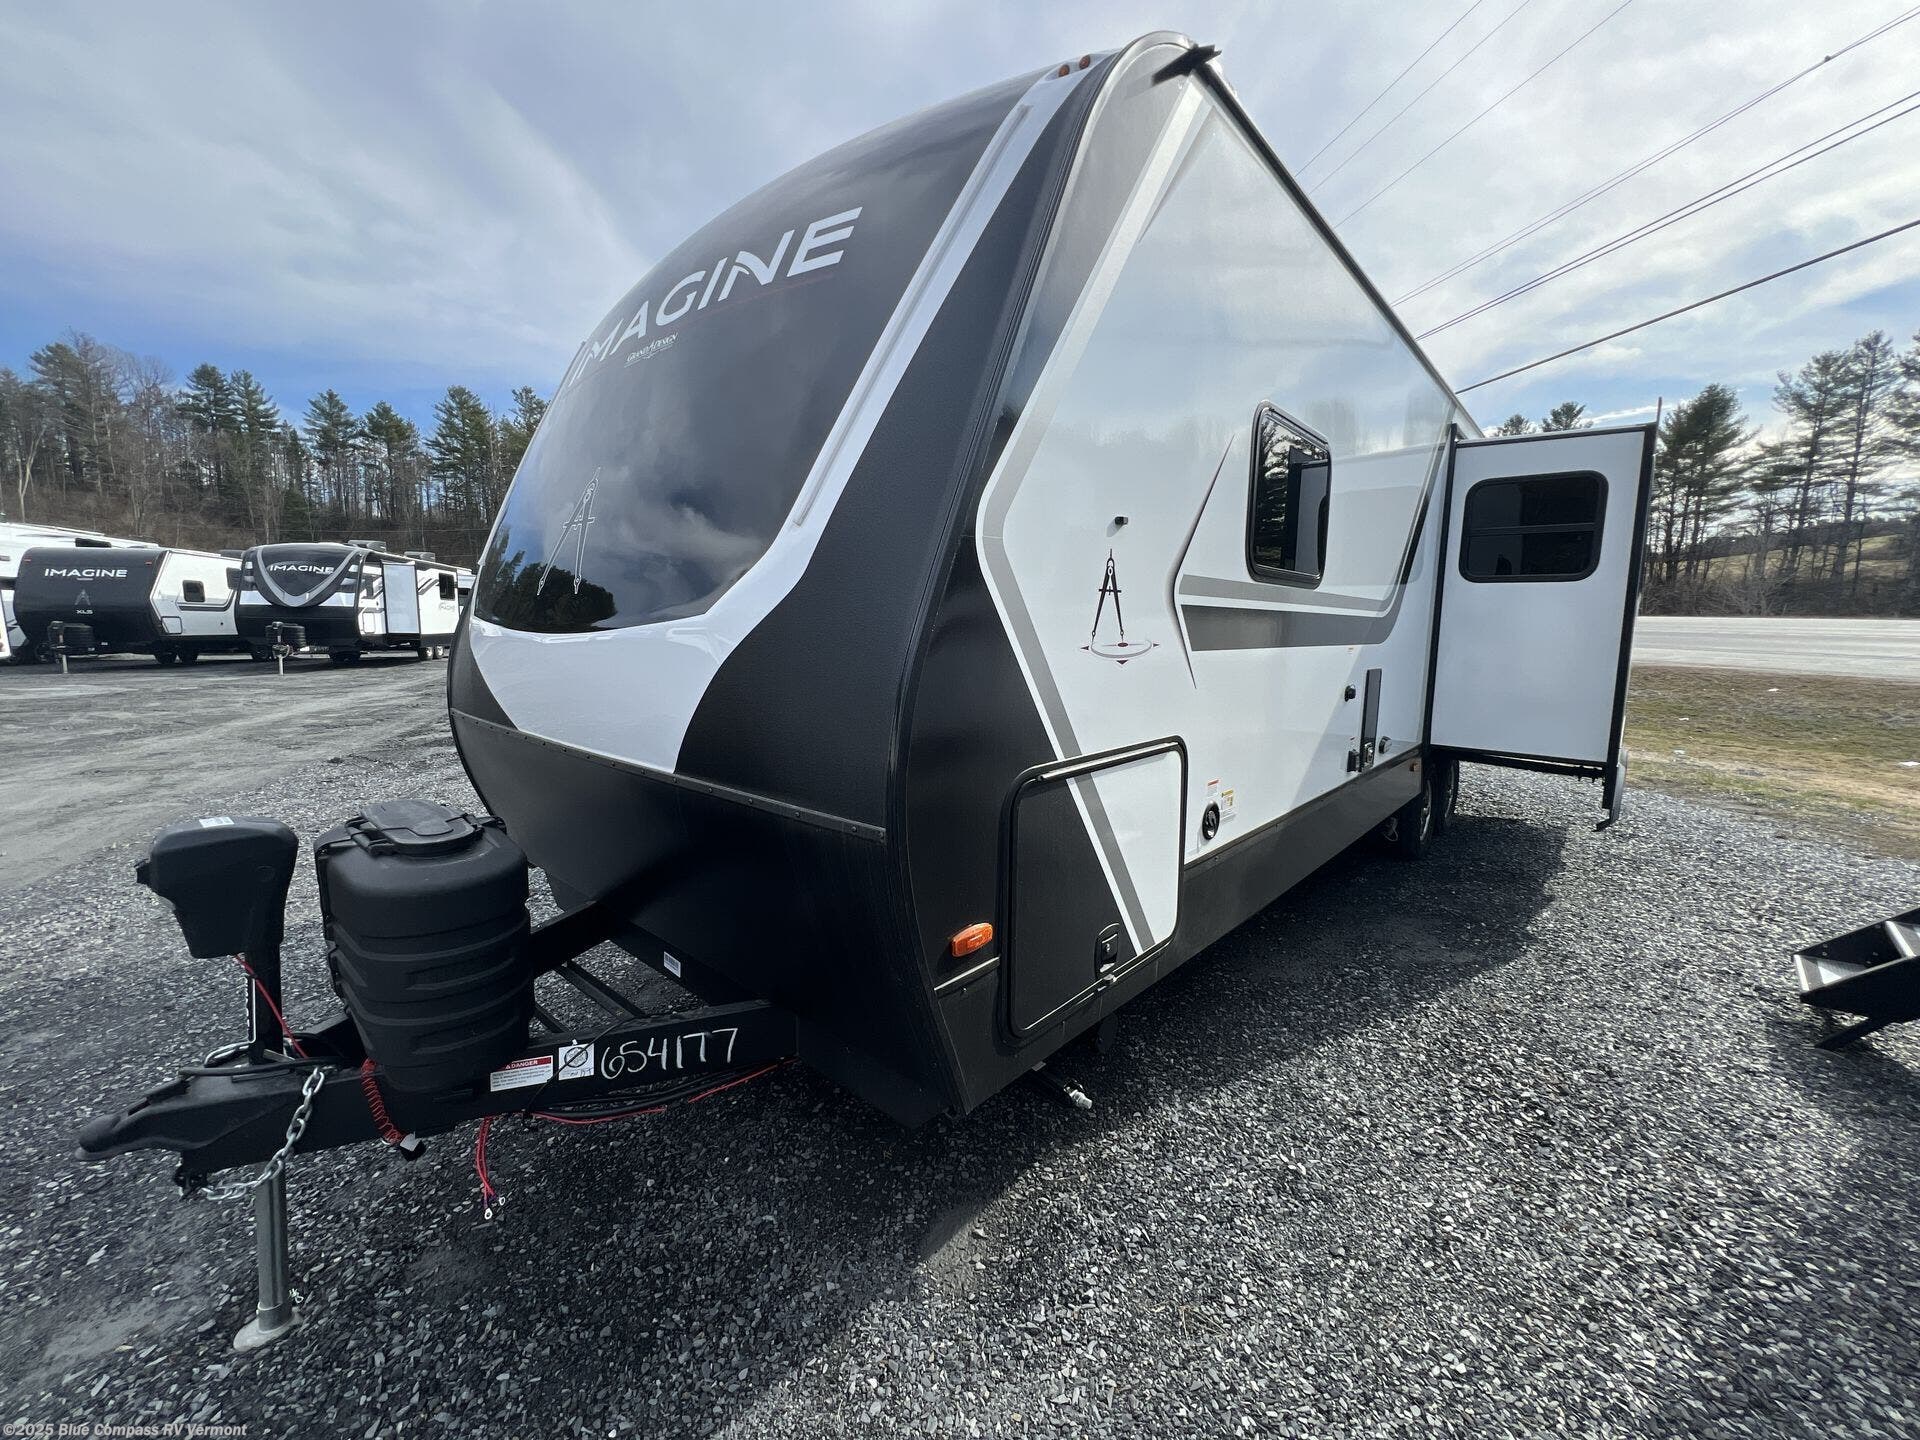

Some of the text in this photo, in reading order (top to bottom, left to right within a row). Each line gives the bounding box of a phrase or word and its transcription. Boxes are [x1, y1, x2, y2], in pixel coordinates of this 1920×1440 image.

[567, 206, 863, 388] IMAGINE
[44, 568, 128, 578] IMAGINE
[269, 564, 335, 574] IMAGINE
[600, 1027, 738, 1080] 654177
[511, 1059, 538, 1069] DANGER
